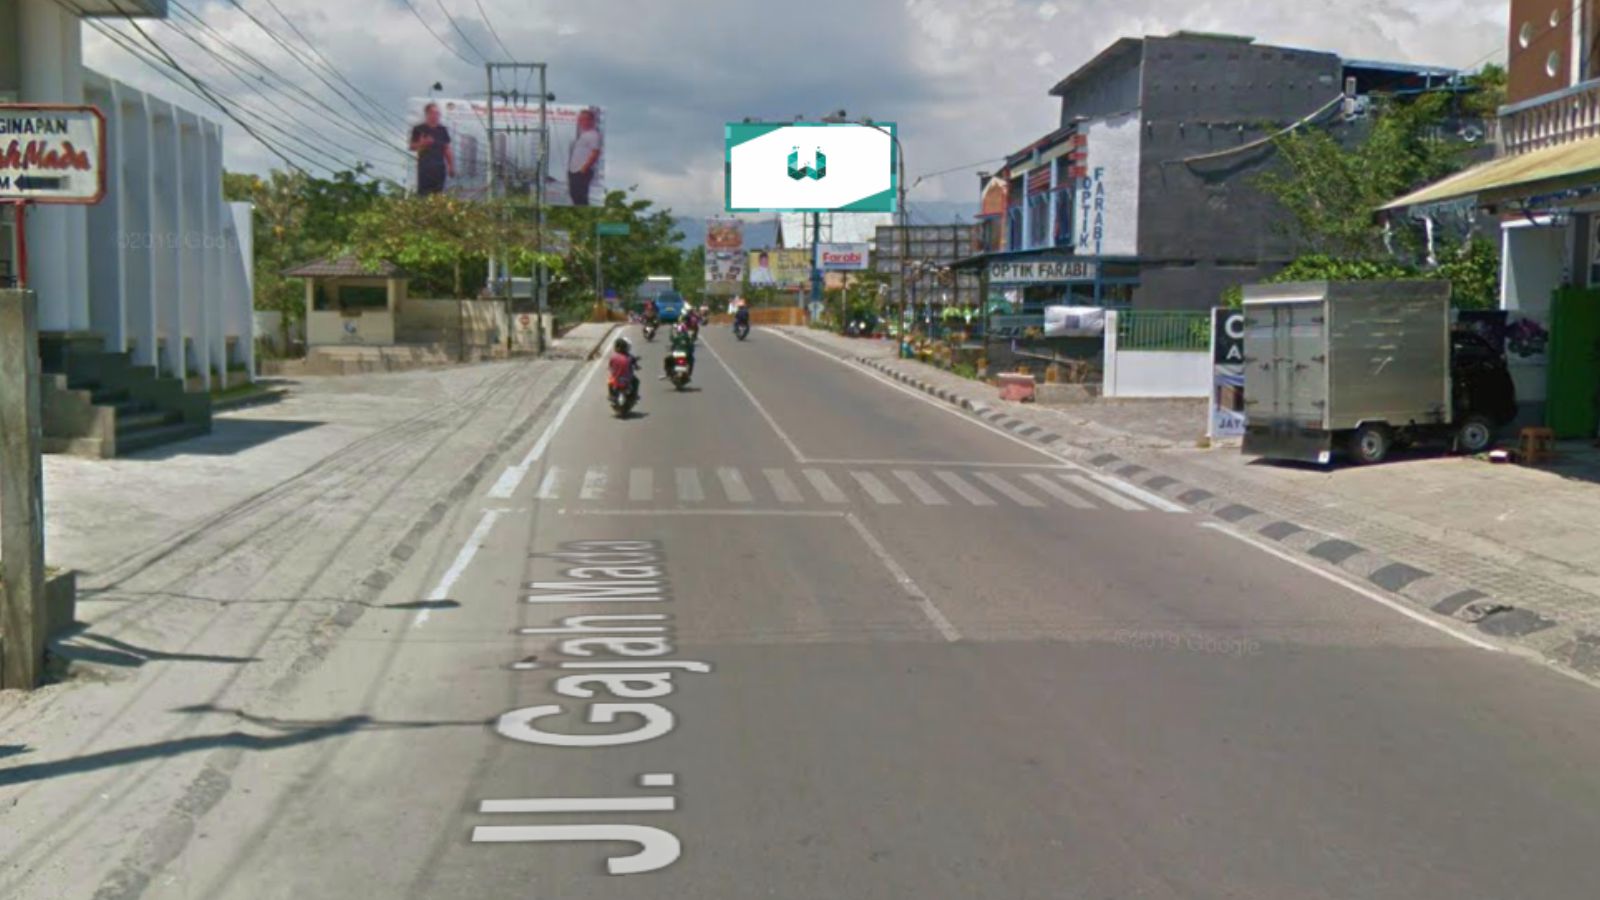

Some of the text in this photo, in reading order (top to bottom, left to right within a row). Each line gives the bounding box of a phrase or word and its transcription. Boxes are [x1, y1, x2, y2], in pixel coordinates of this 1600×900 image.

[1080, 176, 1092, 247] OPTIK
[1093, 167, 1105, 254] FARABI
[991, 263, 1088, 278] OPTIK FARABI
